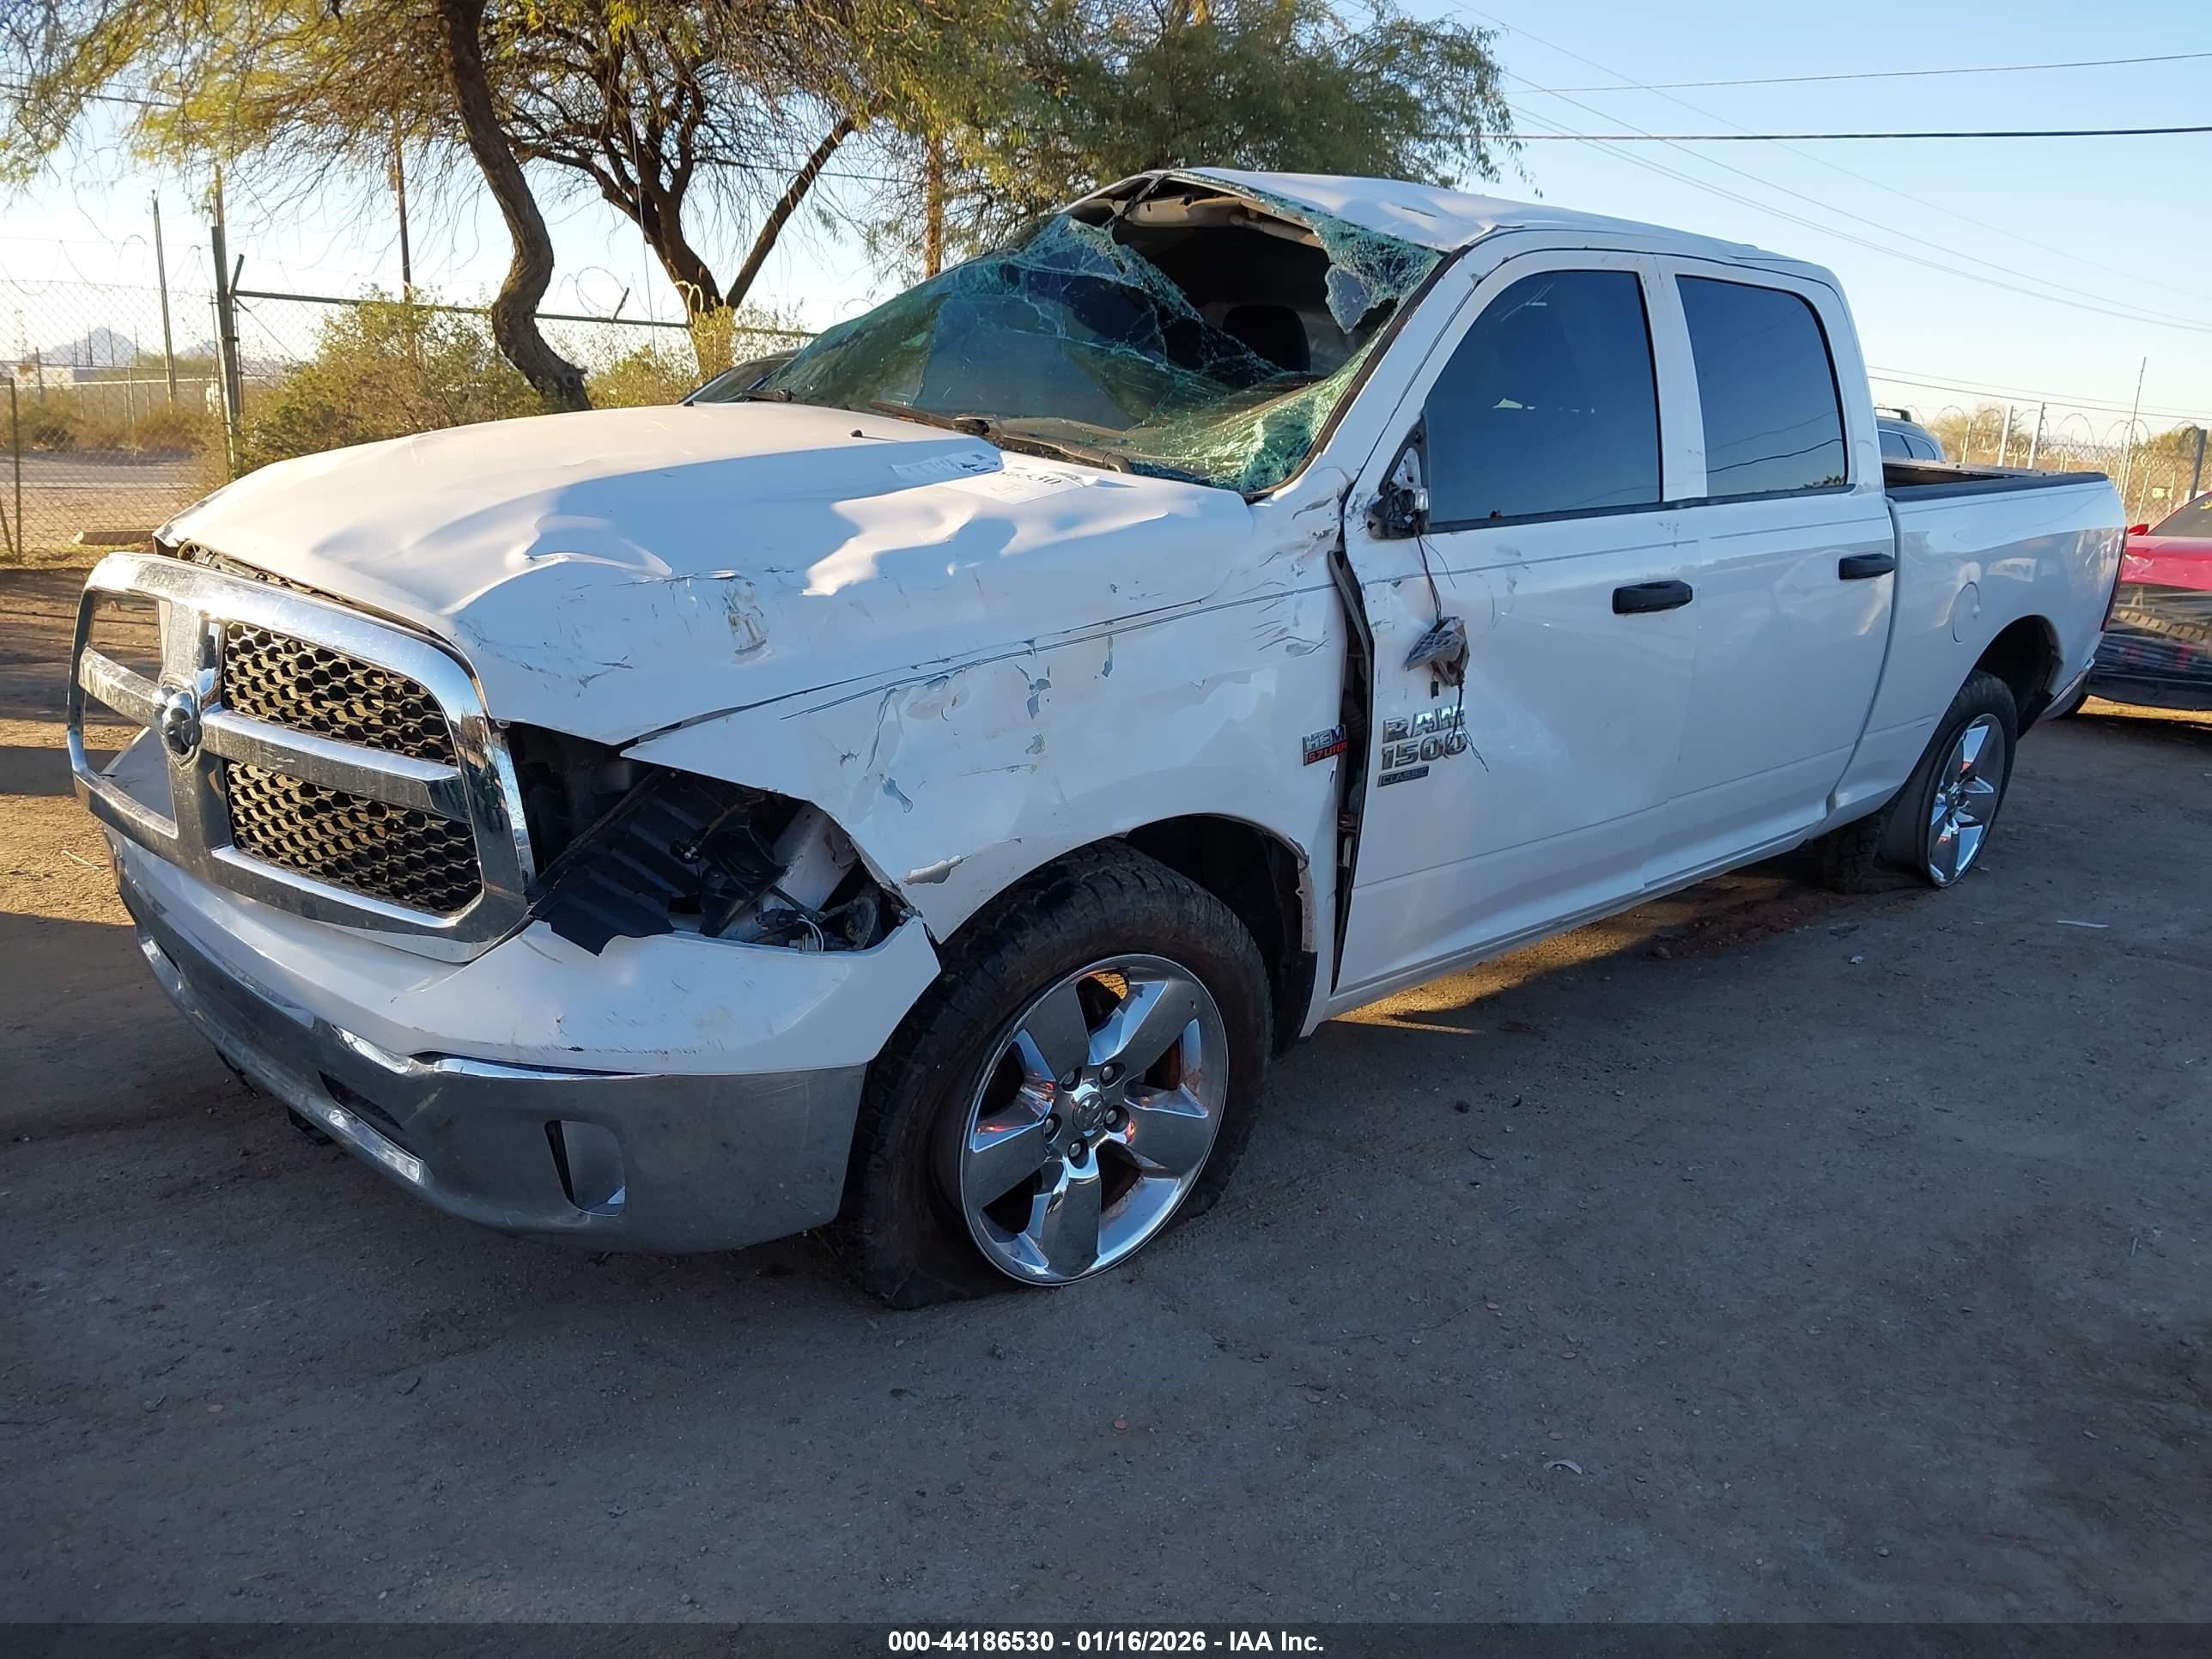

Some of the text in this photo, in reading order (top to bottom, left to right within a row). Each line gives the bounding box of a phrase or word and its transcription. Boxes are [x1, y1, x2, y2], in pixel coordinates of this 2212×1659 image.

[1382, 704, 1466, 744] RAM
[1381, 730, 1468, 770] 1500
[1382, 767, 1428, 785] CLASSIC
